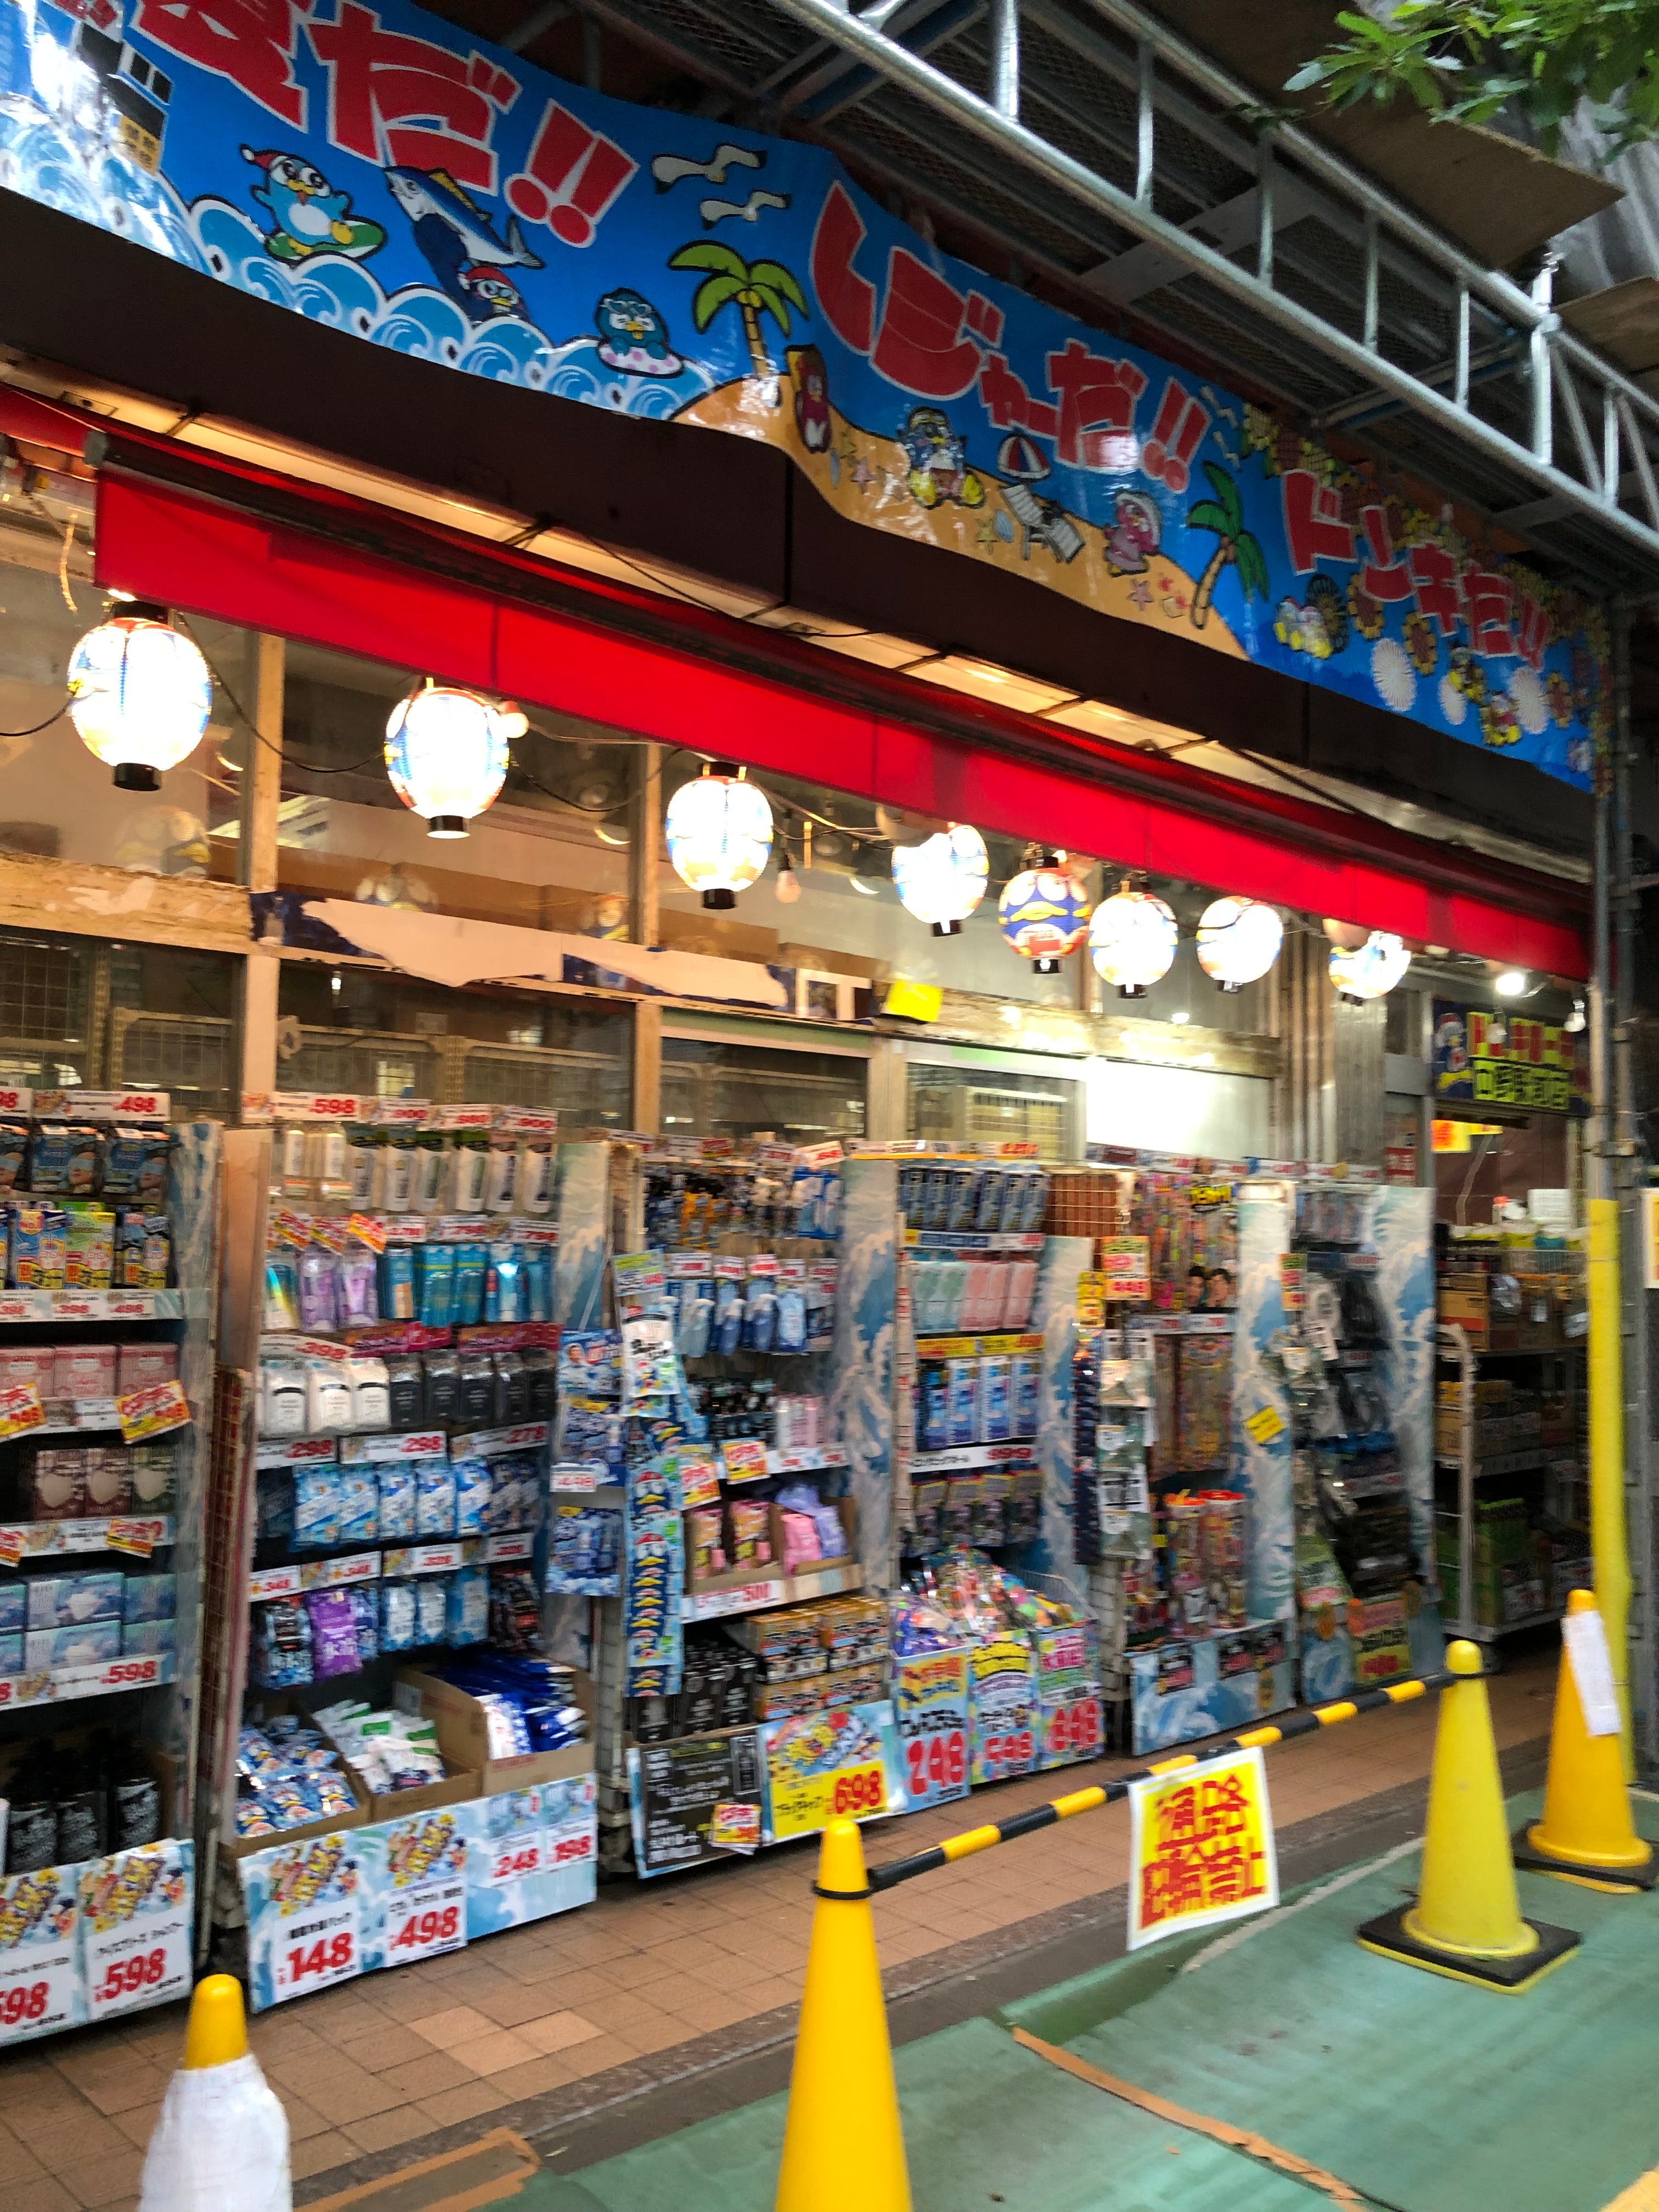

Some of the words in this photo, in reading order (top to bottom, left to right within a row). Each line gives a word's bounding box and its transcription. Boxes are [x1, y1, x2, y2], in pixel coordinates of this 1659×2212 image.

[313, 1098, 357, 1114] 598
[404, 1436, 442, 1453] 298
[109, 1661, 156, 1684] 598
[399, 1906, 460, 1948] 498
[105, 1948, 166, 2001] 598
[287, 1932, 353, 1983] 148
[0, 1982, 49, 2025] 98
